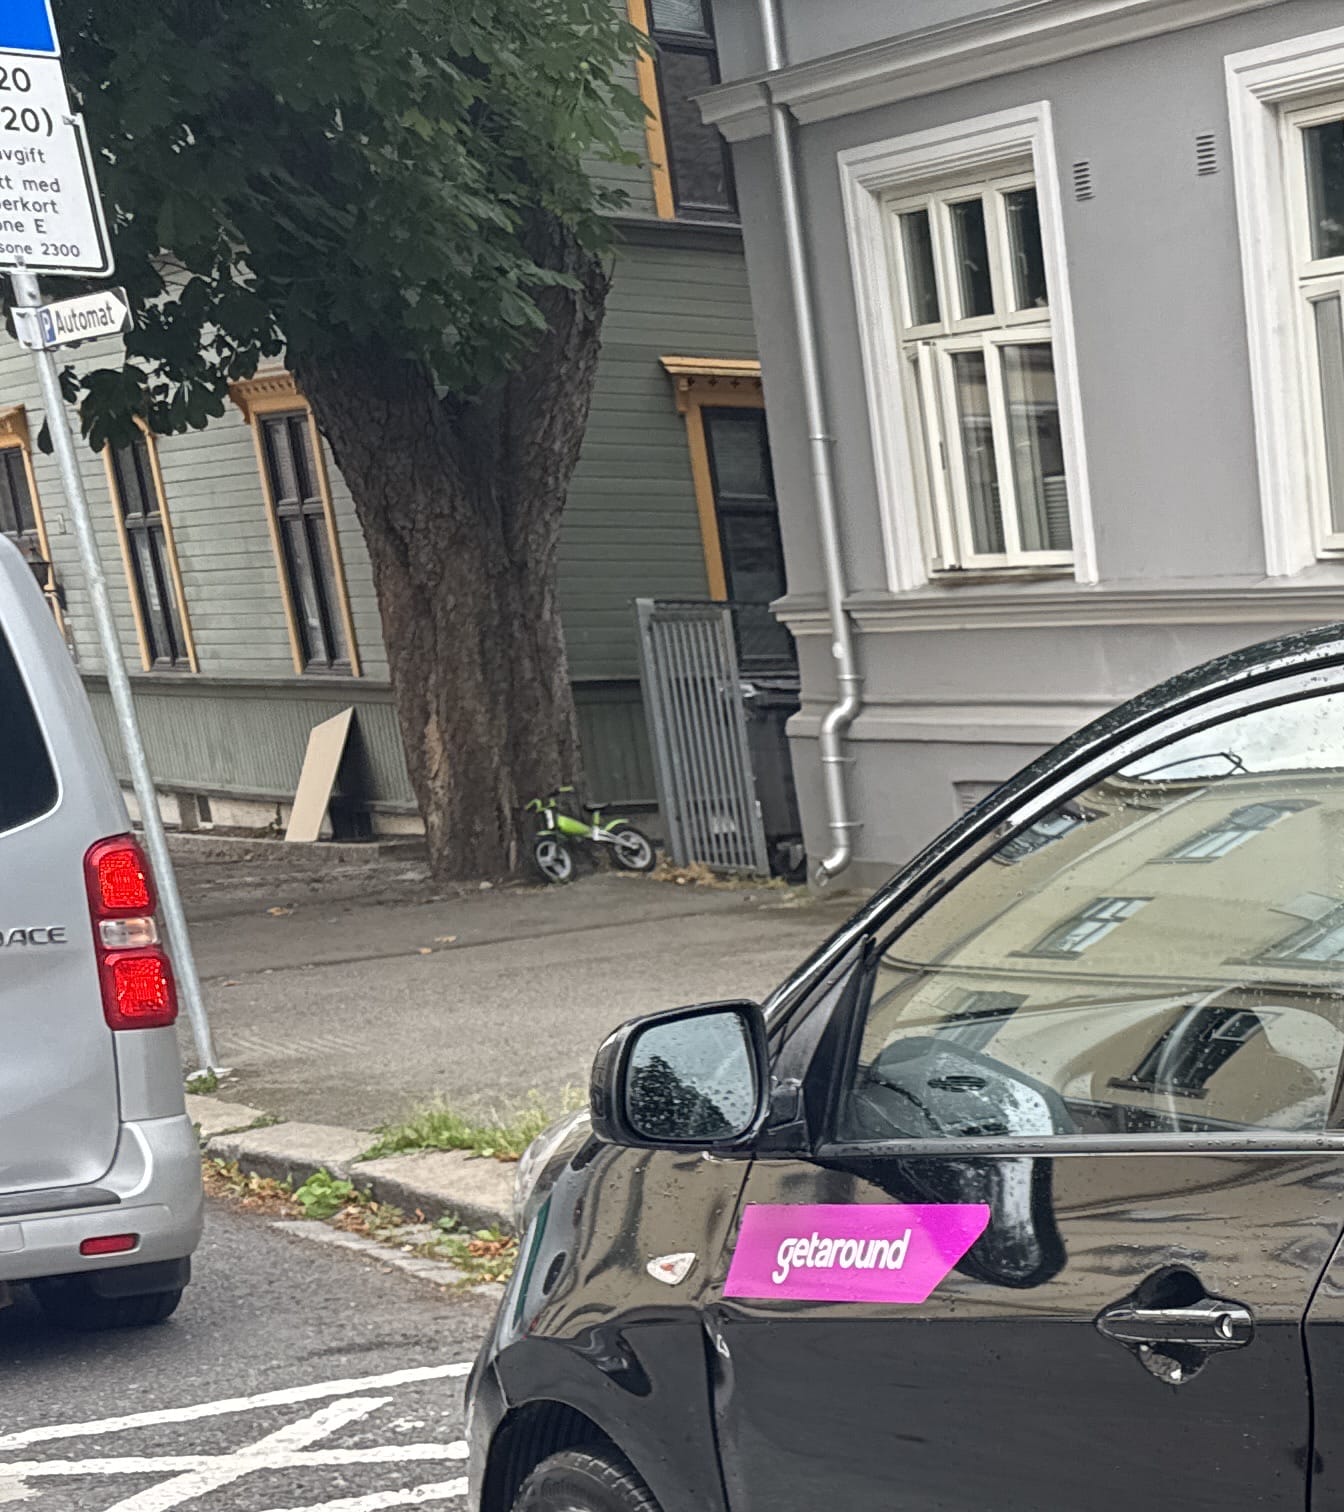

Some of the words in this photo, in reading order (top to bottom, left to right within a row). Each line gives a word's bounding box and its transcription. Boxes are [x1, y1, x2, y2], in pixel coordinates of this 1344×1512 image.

[0, 106, 53, 137] 20)
[0, 147, 46, 166] vgift
[22, 177, 61, 193] med
[0, 197, 59, 215] erkort
[0, 219, 24, 233] ne
[34, 218, 47, 234] E
[40, 242, 80, 258] 2300
[55, 300, 115, 335] Automat
[0, 927, 68, 947] ACE
[771, 1228, 912, 1285] getaround
